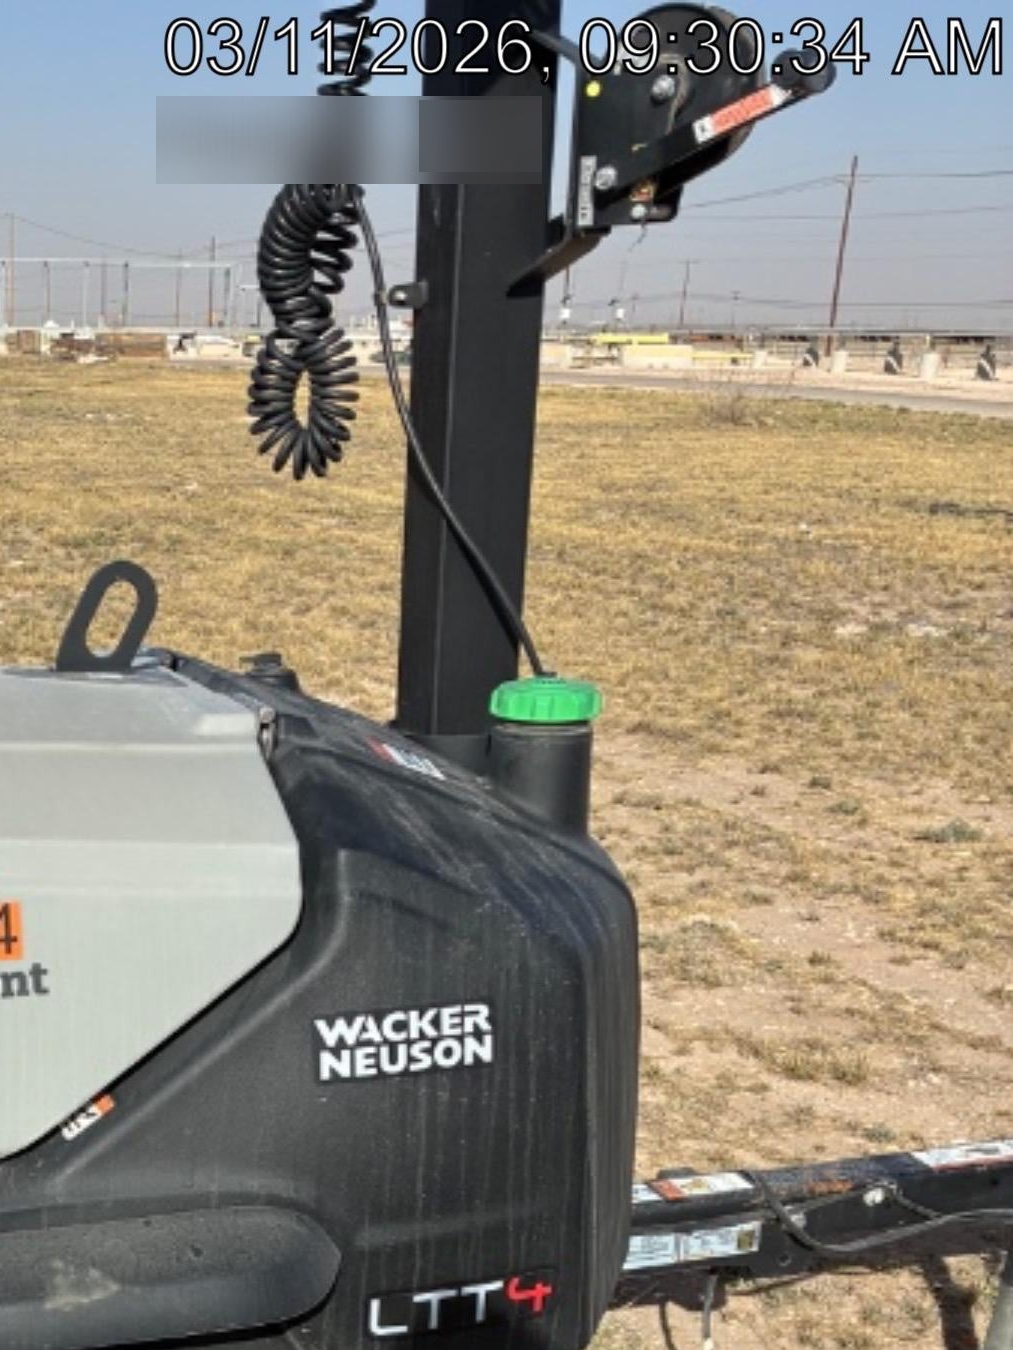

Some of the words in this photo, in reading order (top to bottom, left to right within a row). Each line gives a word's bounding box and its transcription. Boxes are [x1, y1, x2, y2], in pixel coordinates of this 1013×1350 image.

[314, 1003, 492, 1048] WACKER
[319, 1034, 492, 1081] NEUSON
[368, 1276, 552, 1337] LTT4
